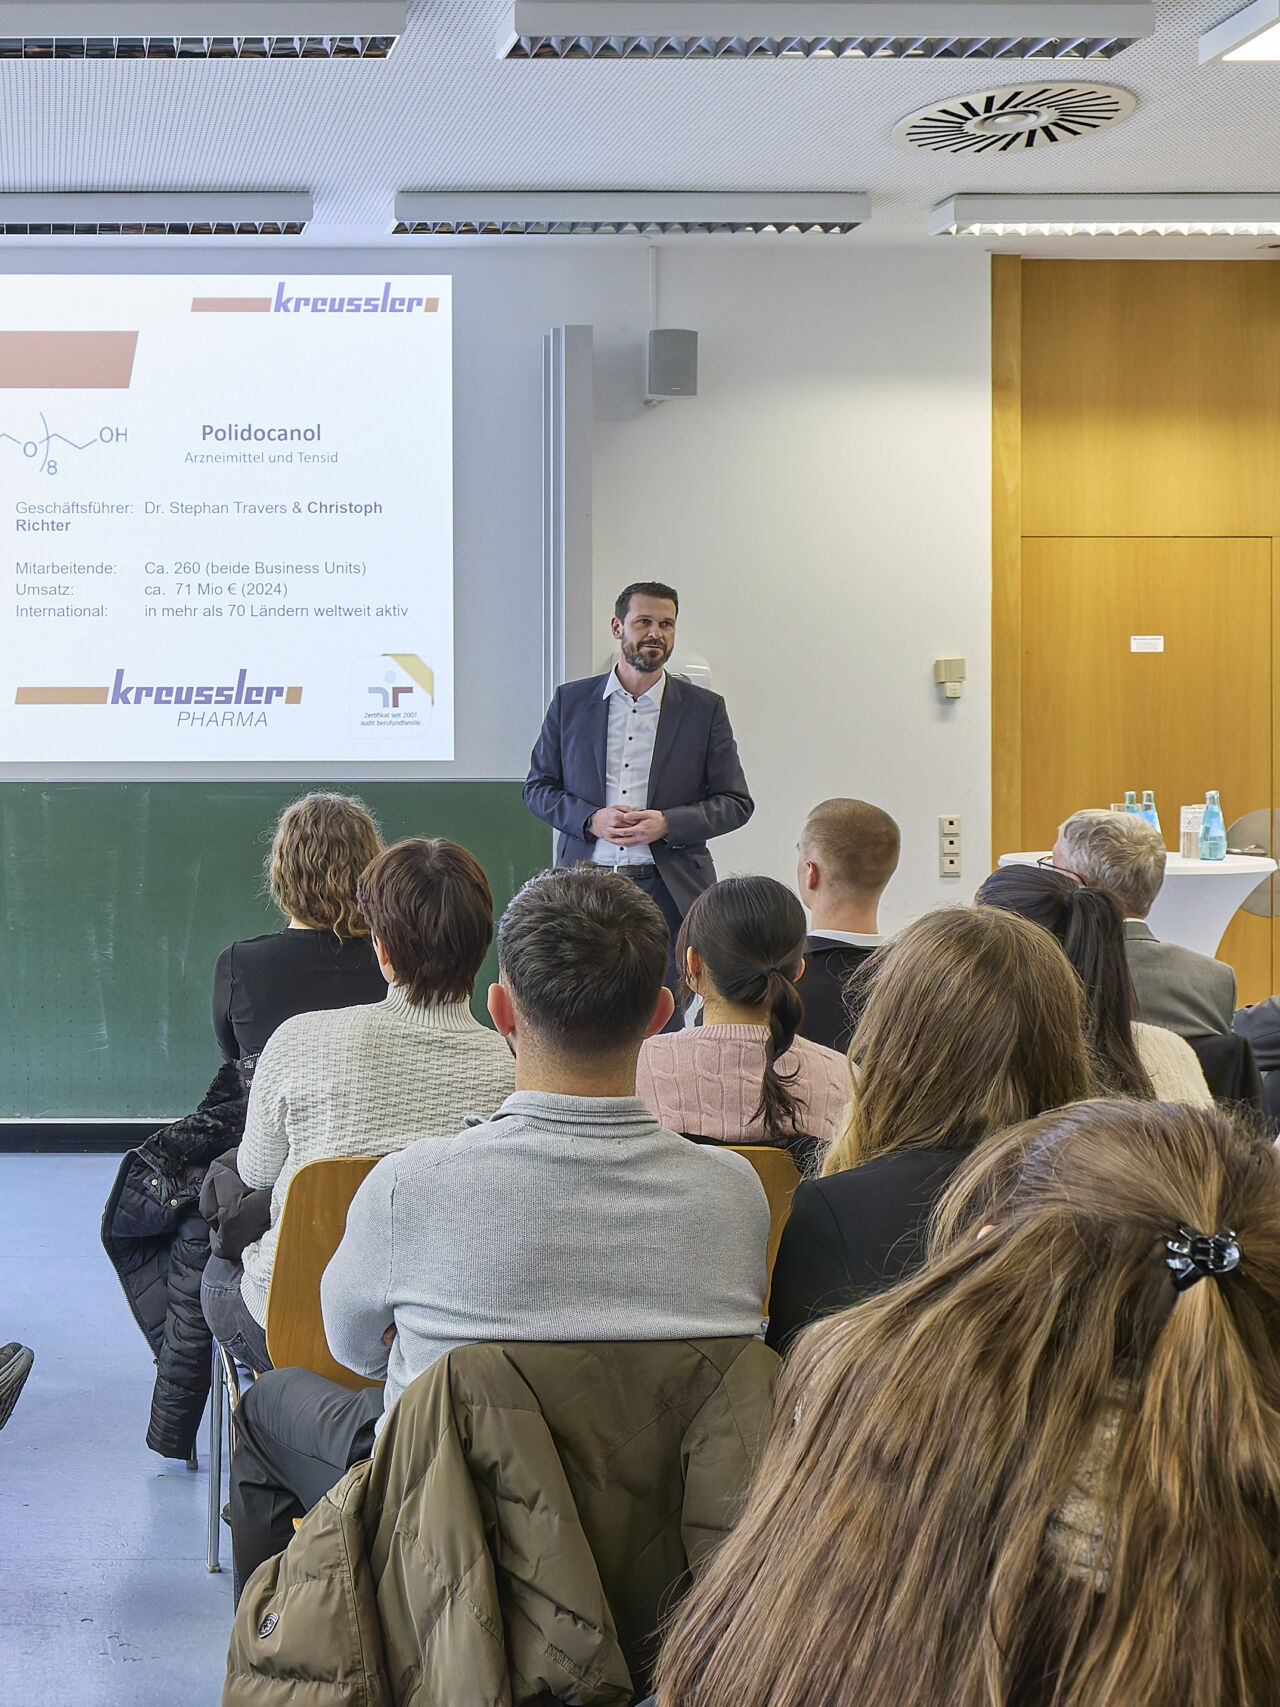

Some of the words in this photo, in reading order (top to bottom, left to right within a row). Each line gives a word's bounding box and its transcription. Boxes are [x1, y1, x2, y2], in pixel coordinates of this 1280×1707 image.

[273, 281, 424, 313] kreussler
[99, 426, 128, 444] OH
[202, 423, 321, 442] Polidocanol
[184, 451, 263, 464] Arzneimittel
[268, 451, 293, 464] und
[297, 451, 338, 464] Tensid
[47, 460, 58, 476] 8
[15, 501, 134, 514] Geschäftsführer:
[144, 501, 165, 514] Dr.
[170, 501, 229, 517] Stephan
[233, 501, 287, 514] Travers
[292, 501, 303, 514] &
[307, 501, 383, 517] Christoph
[15, 519, 72, 532] Richter
[15, 561, 117, 575] Mitarbeitende:
[144, 561, 169, 575] Ca.
[173, 561, 201, 575] 260
[205, 561, 250, 577] (beide
[254, 561, 320, 575] Business
[324, 561, 367, 577] Units)
[15, 583, 74, 596] Umsatz:
[144, 585, 166, 596] ca.
[175, 583, 191, 596] 71
[197, 583, 224, 596] Mio
[227, 583, 237, 596] €
[241, 582, 288, 599] (2024)
[16, 604, 108, 617] International:
[144, 604, 157, 617] in
[161, 604, 199, 617] mehr
[203, 604, 223, 617] als
[228, 604, 246, 617] 70
[250, 604, 309, 617] Ländern
[313, 604, 372, 617] weltweit
[376, 604, 409, 617] aktiv
[110, 668, 284, 705] kreussler
[177, 711, 268, 728] PHARMA
